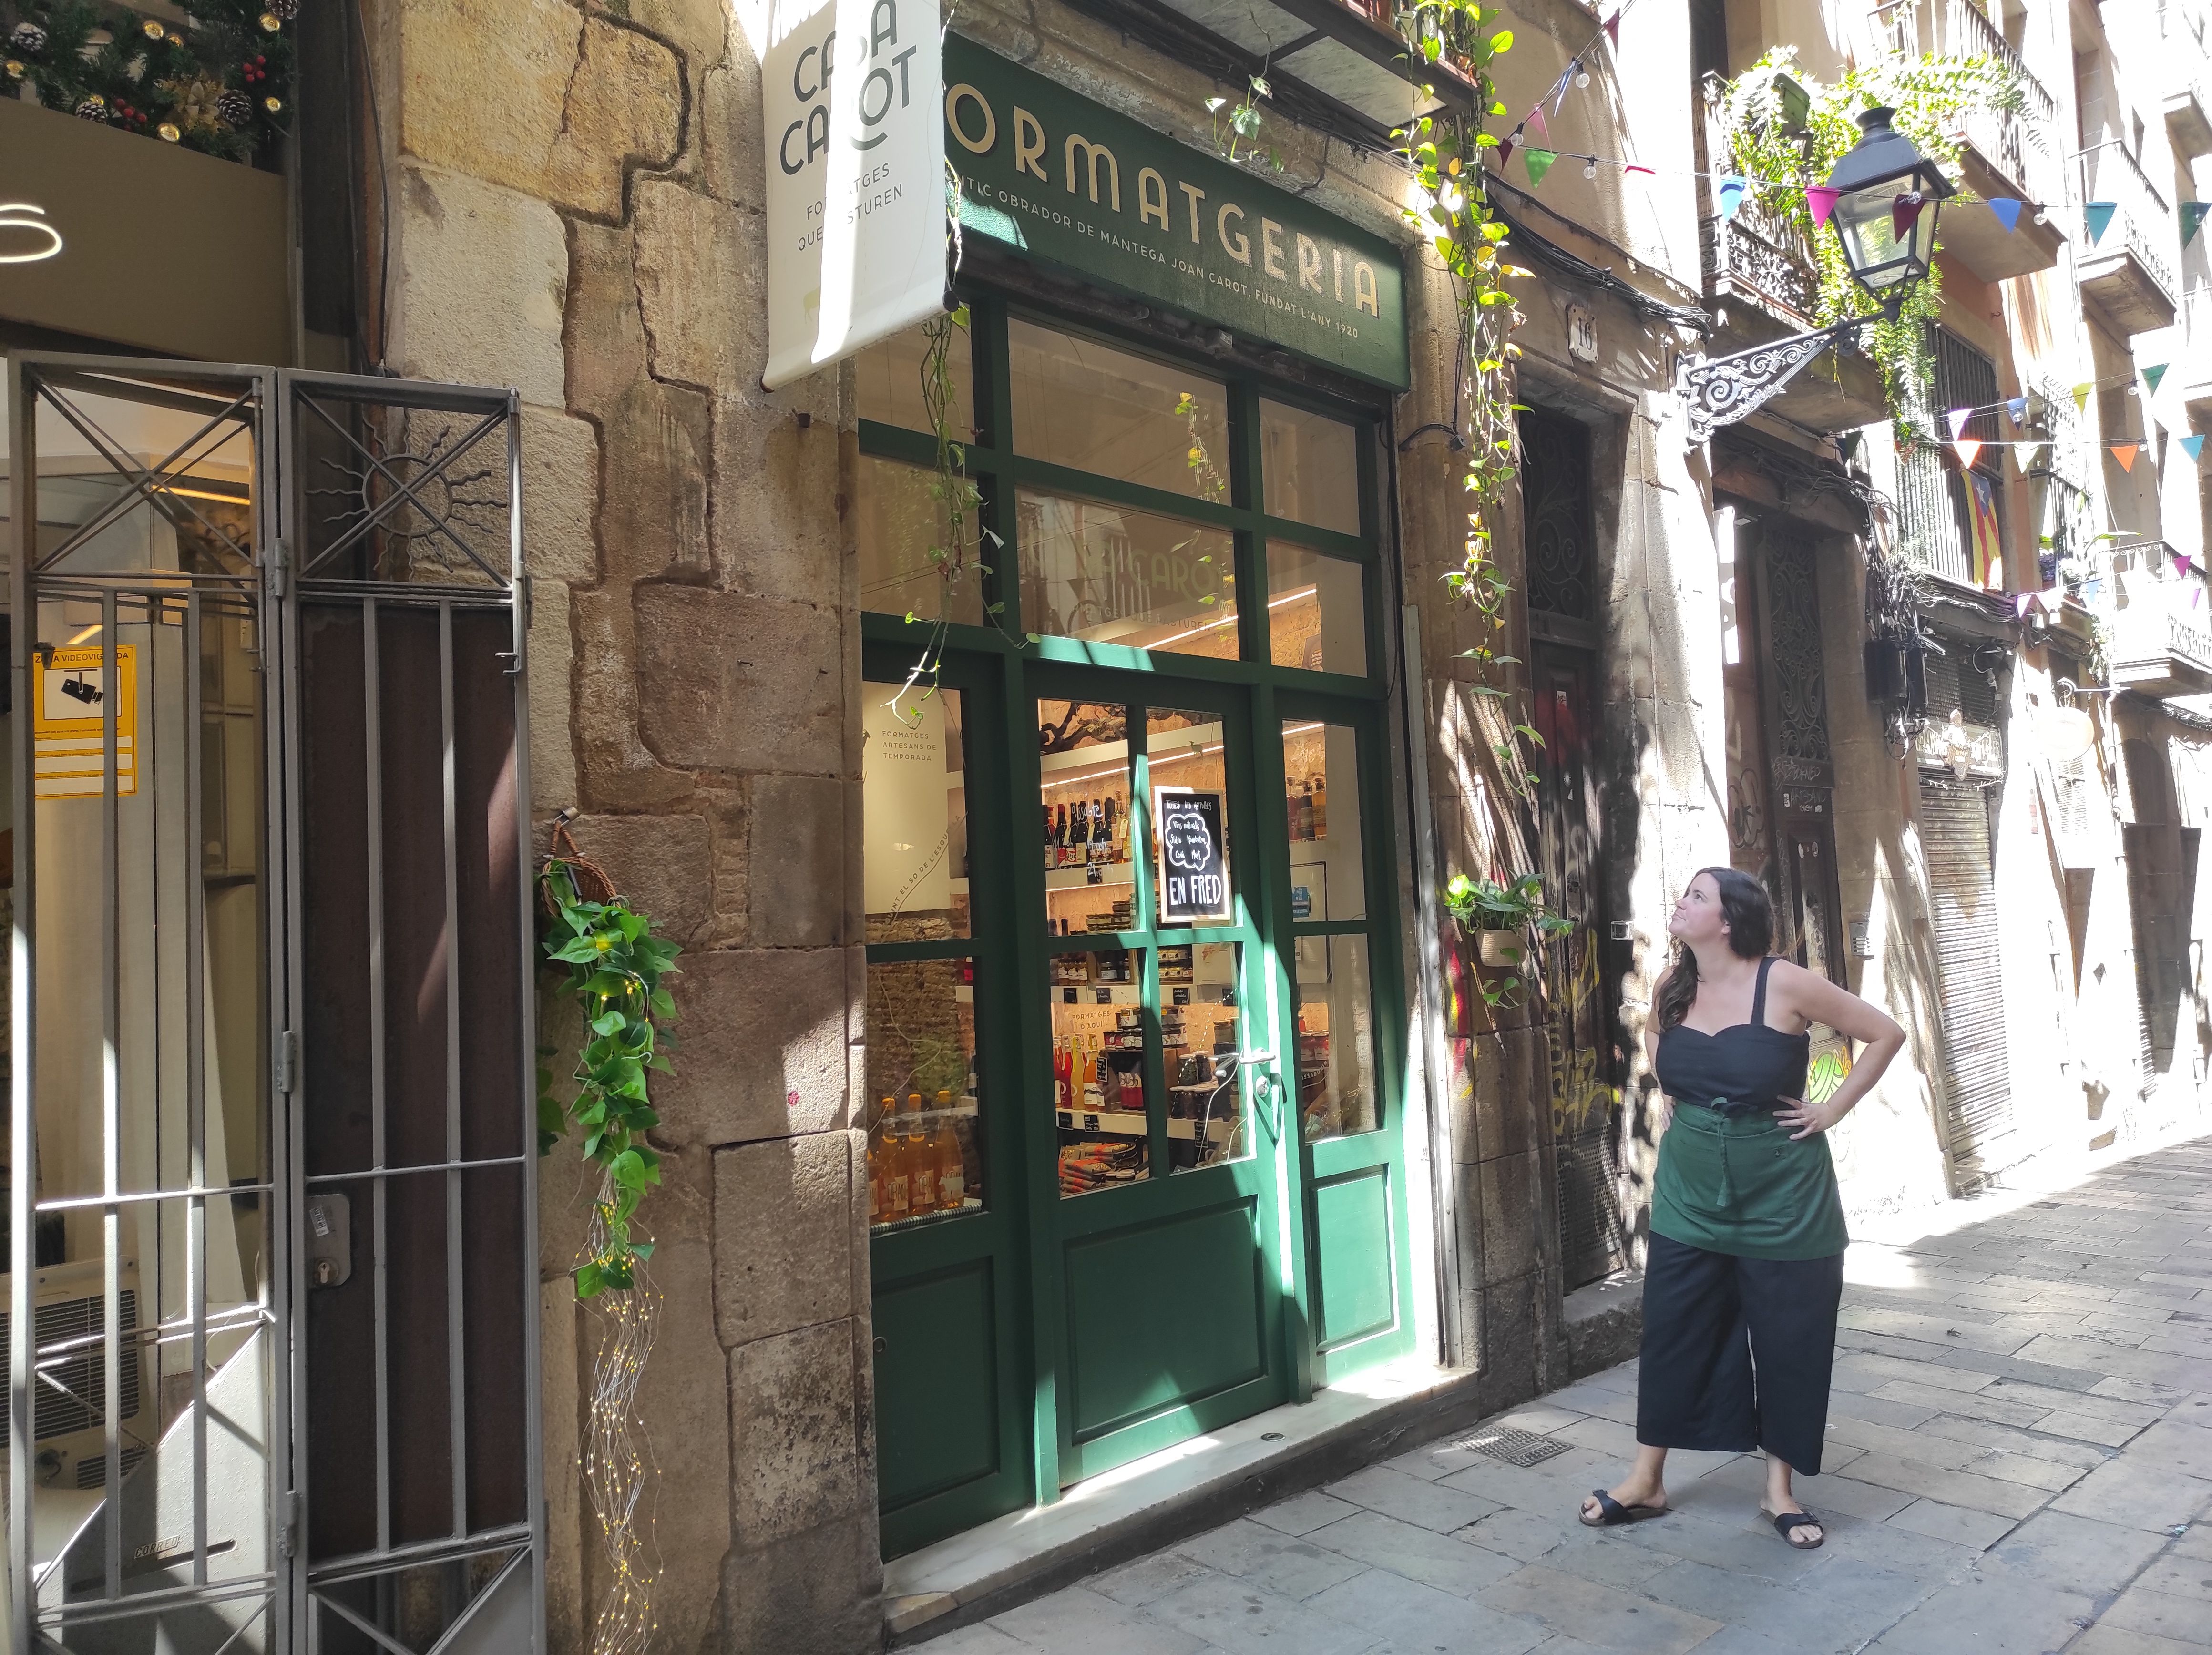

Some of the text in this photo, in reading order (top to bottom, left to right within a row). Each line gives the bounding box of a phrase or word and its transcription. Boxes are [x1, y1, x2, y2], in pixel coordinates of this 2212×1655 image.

[794, 0, 897, 102] CAA
[780, 44, 916, 175] CAOT
[807, 163, 889, 220] FOTGES
[946, 83, 1381, 318] ORMATGERIA
[798, 226, 823, 251] QUE
[999, 190, 1072, 228] OBRADOR
[1077, 221, 1095, 237] DE
[1100, 230, 1167, 264] MANTEGA
[1171, 258, 1205, 279] JOAN
[1209, 272, 1252, 298] CAROT,
[1255, 289, 1298, 314] FUNDAT
[1301, 307, 1331, 328] L'ANY
[1336, 322, 1359, 338] 1920
[1578, 317, 1593, 350] 16
[61, 652, 129, 663] VIDEOVIGDA
[882, 730, 929, 740] FORMATGES
[882, 742, 924, 750] ARTESANS
[883, 753, 932, 761] TEMPORADA
[900, 886, 909, 895] EL
[909, 873, 918, 883] SO
[919, 862, 929, 873] DE
[1169, 875, 1222, 905] EN FRED
[1072, 1011, 1111, 1020] FORMATGES
[135, 1537, 177, 1557] CORREO
